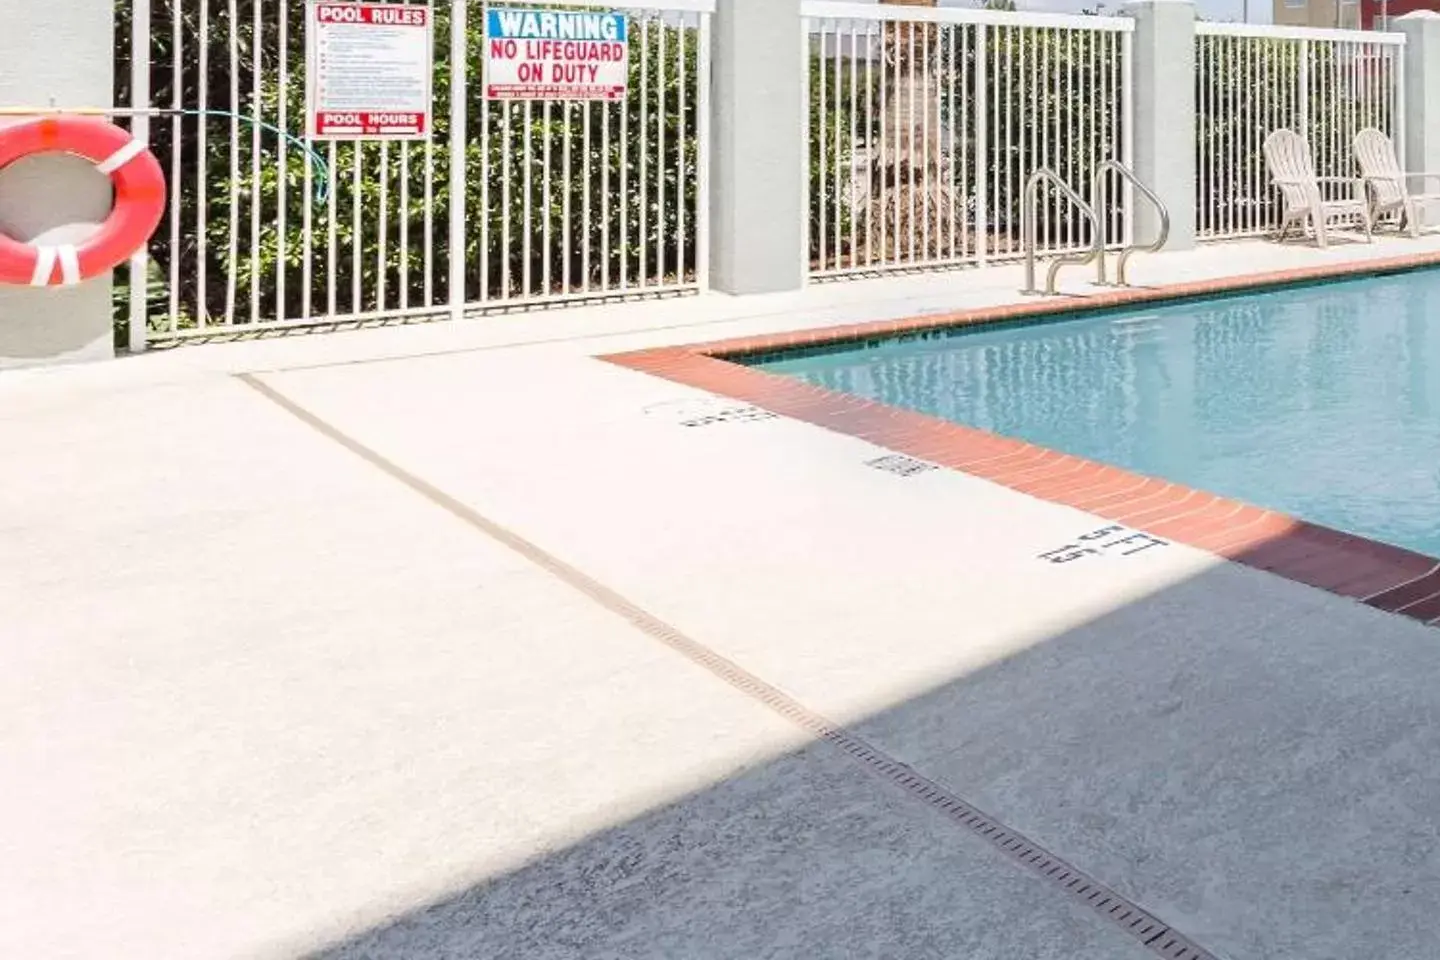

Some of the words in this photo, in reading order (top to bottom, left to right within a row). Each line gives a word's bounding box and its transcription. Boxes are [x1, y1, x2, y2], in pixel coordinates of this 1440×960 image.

[320, 6, 365, 23] POOL
[372, 8, 423, 25] RULES
[498, 11, 618, 40] WARNING
[491, 40, 517, 59] NO
[526, 41, 623, 61] LIFEGUARD
[518, 62, 543, 83] ON
[552, 63, 599, 83] DUTY
[324, 114, 364, 125] POOL
[368, 114, 418, 125] HOURS
